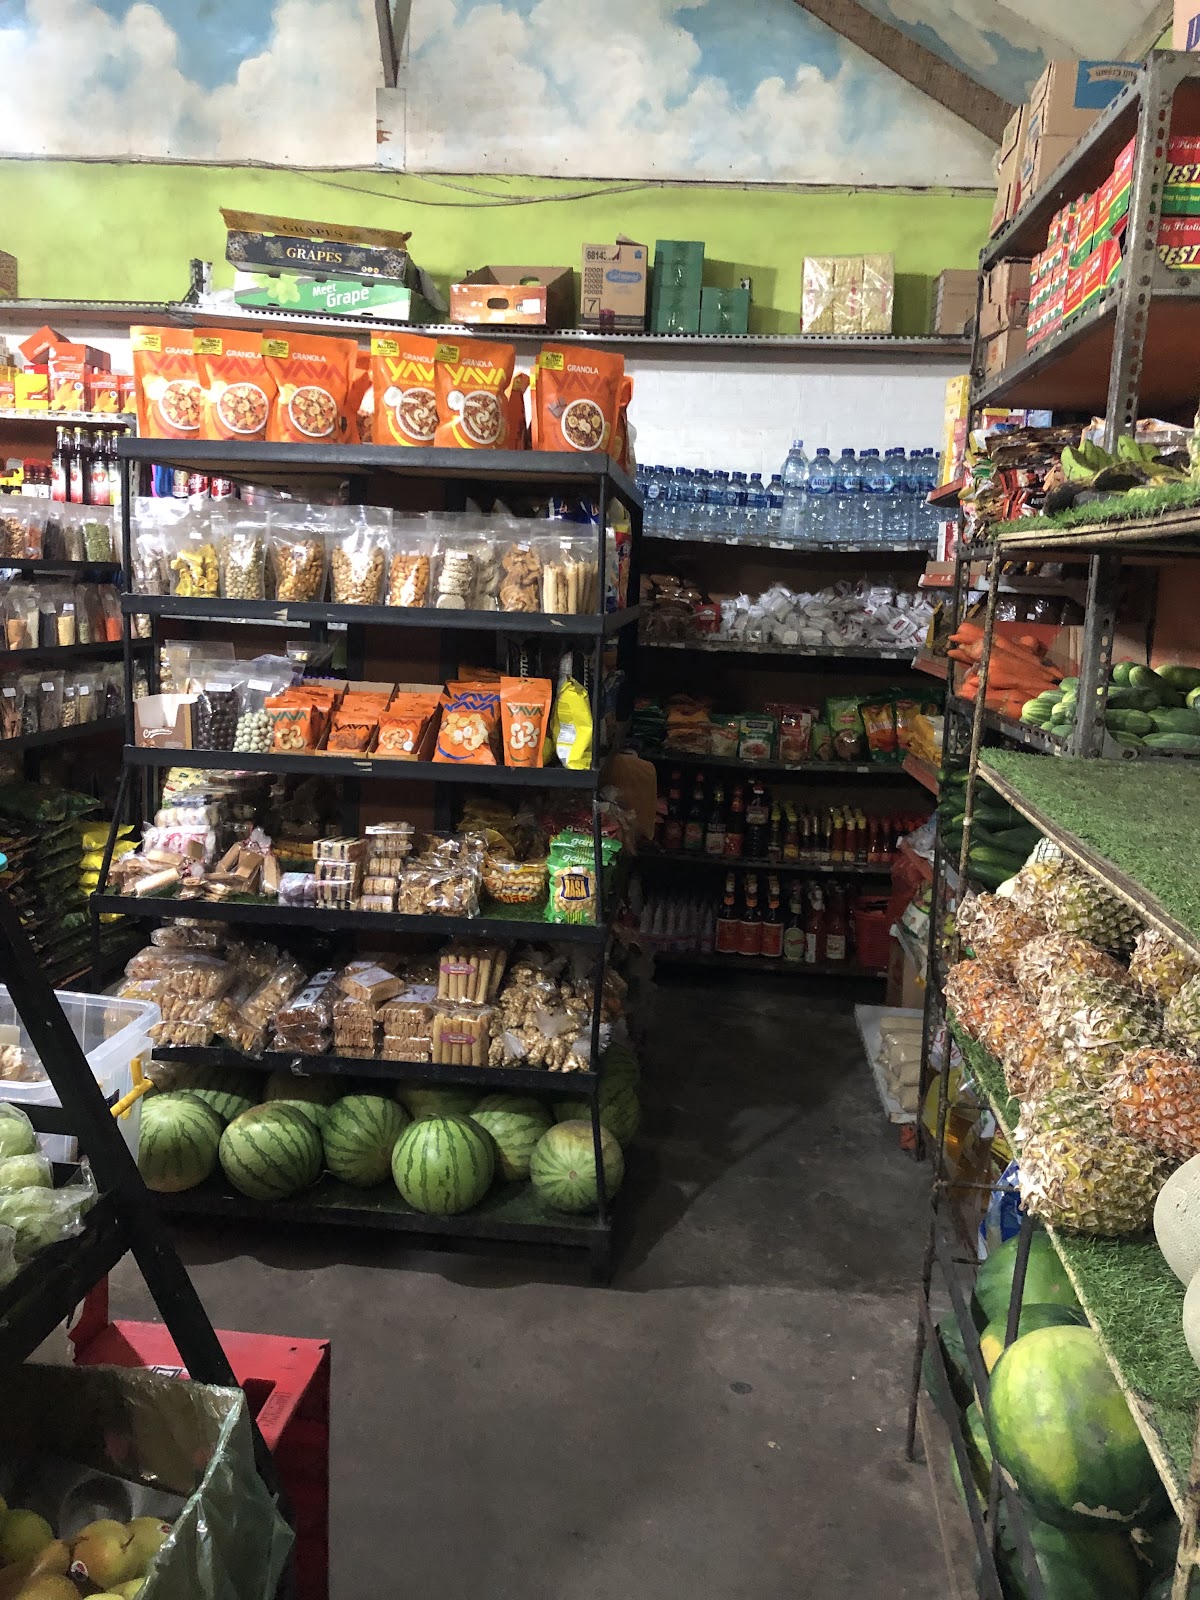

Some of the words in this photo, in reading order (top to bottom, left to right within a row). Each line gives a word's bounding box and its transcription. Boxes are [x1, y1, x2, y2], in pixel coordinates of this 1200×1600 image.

[282, 223, 343, 238] GRAPES
[286, 247, 343, 263] GRAPES
[312, 283, 337, 297] Meet
[326, 288, 370, 308] Grape
[587, 299, 597, 313] 7
[292, 352, 327, 363] GRANOLA
[462, 357, 493, 368] GRANOLA
[567, 364, 599, 374] GRANOLA
